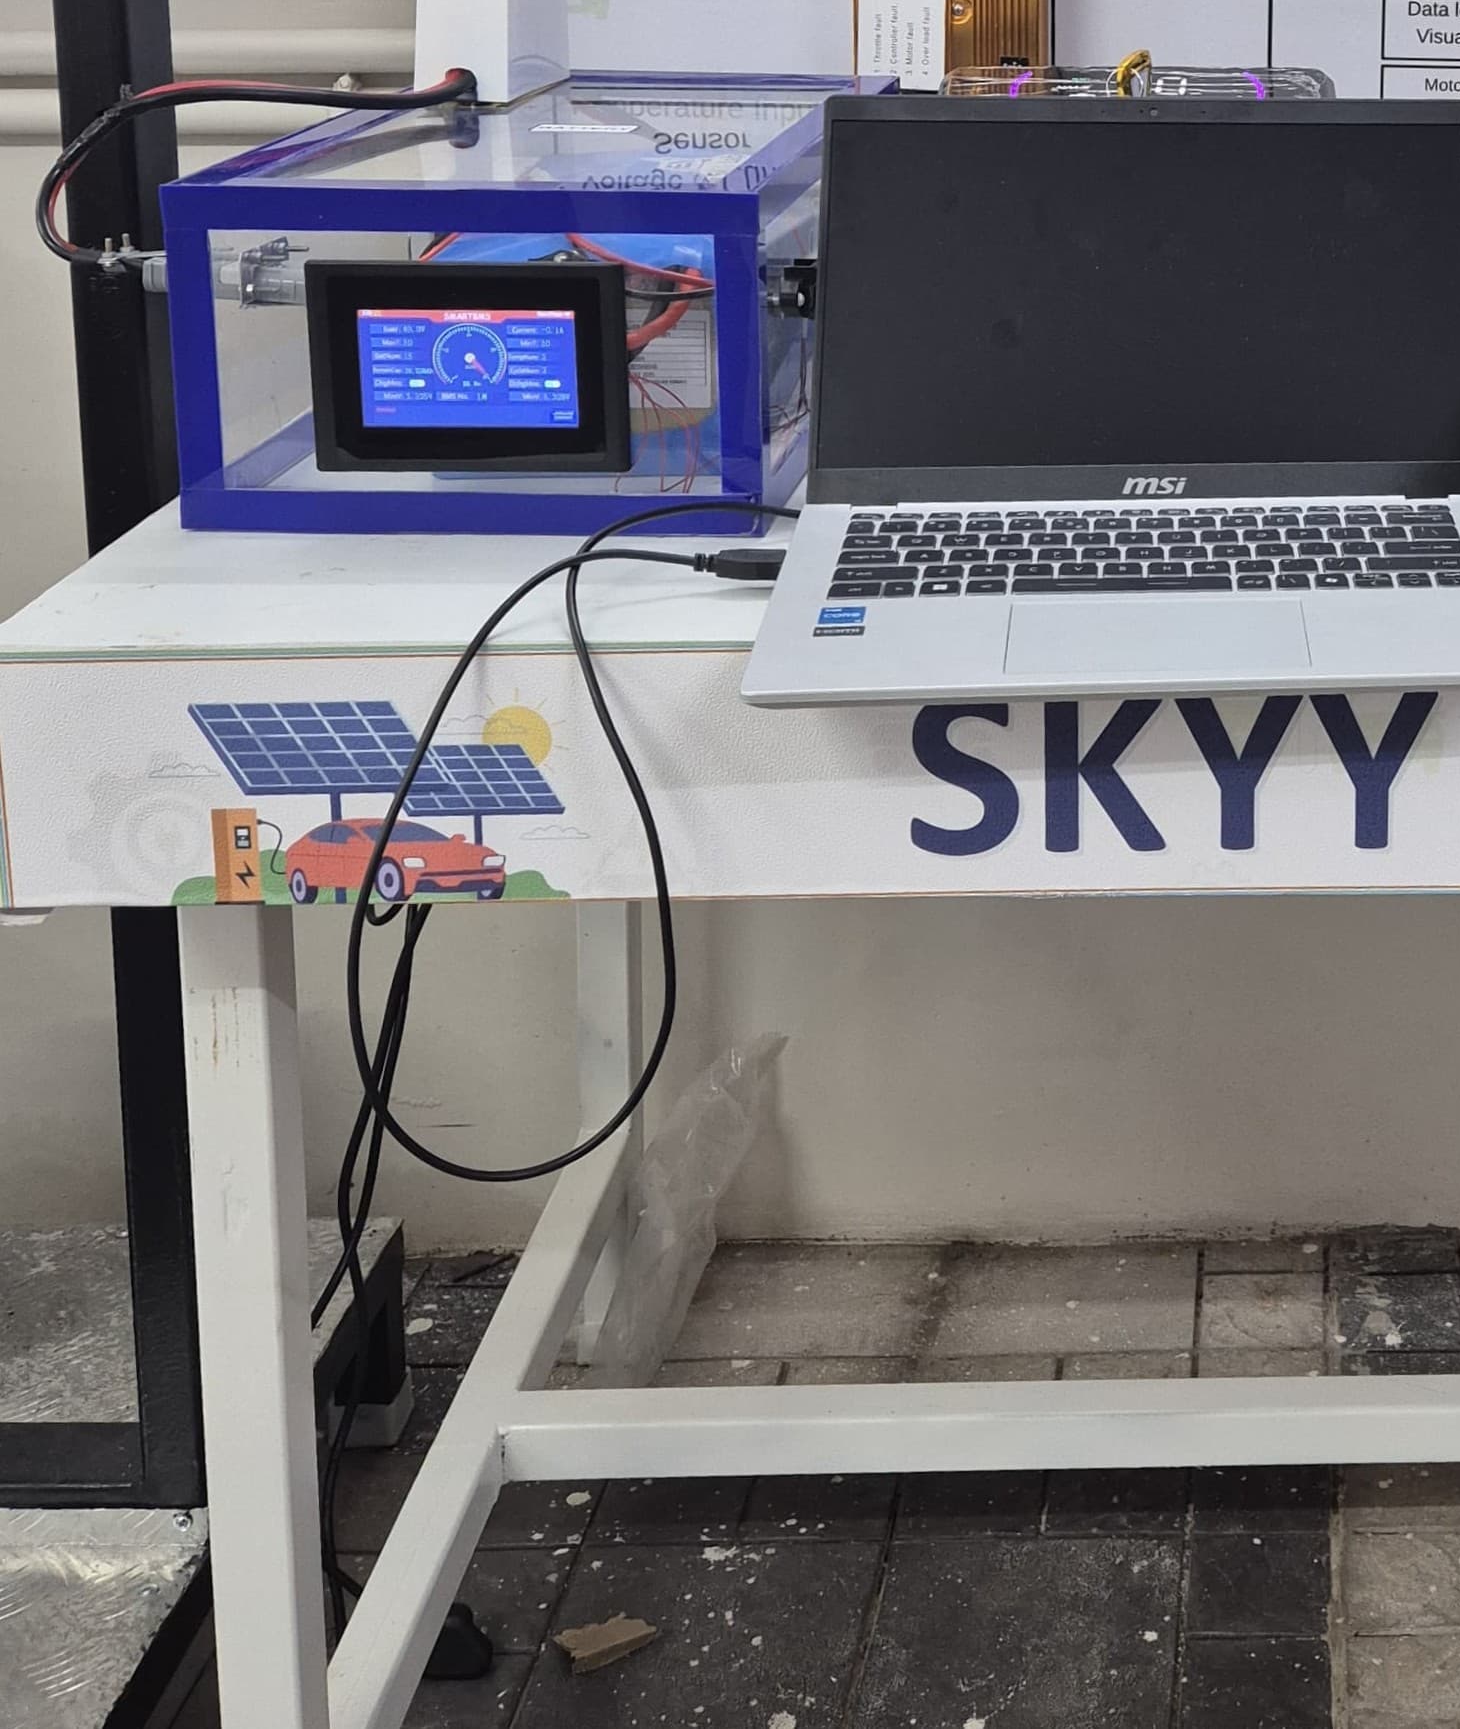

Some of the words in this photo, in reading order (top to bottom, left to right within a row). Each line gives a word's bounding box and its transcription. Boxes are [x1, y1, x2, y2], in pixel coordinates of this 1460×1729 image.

[1408, 1, 1450, 17] Data
[1122, 476, 1188, 495] msi
[908, 690, 1440, 855] SKYY
